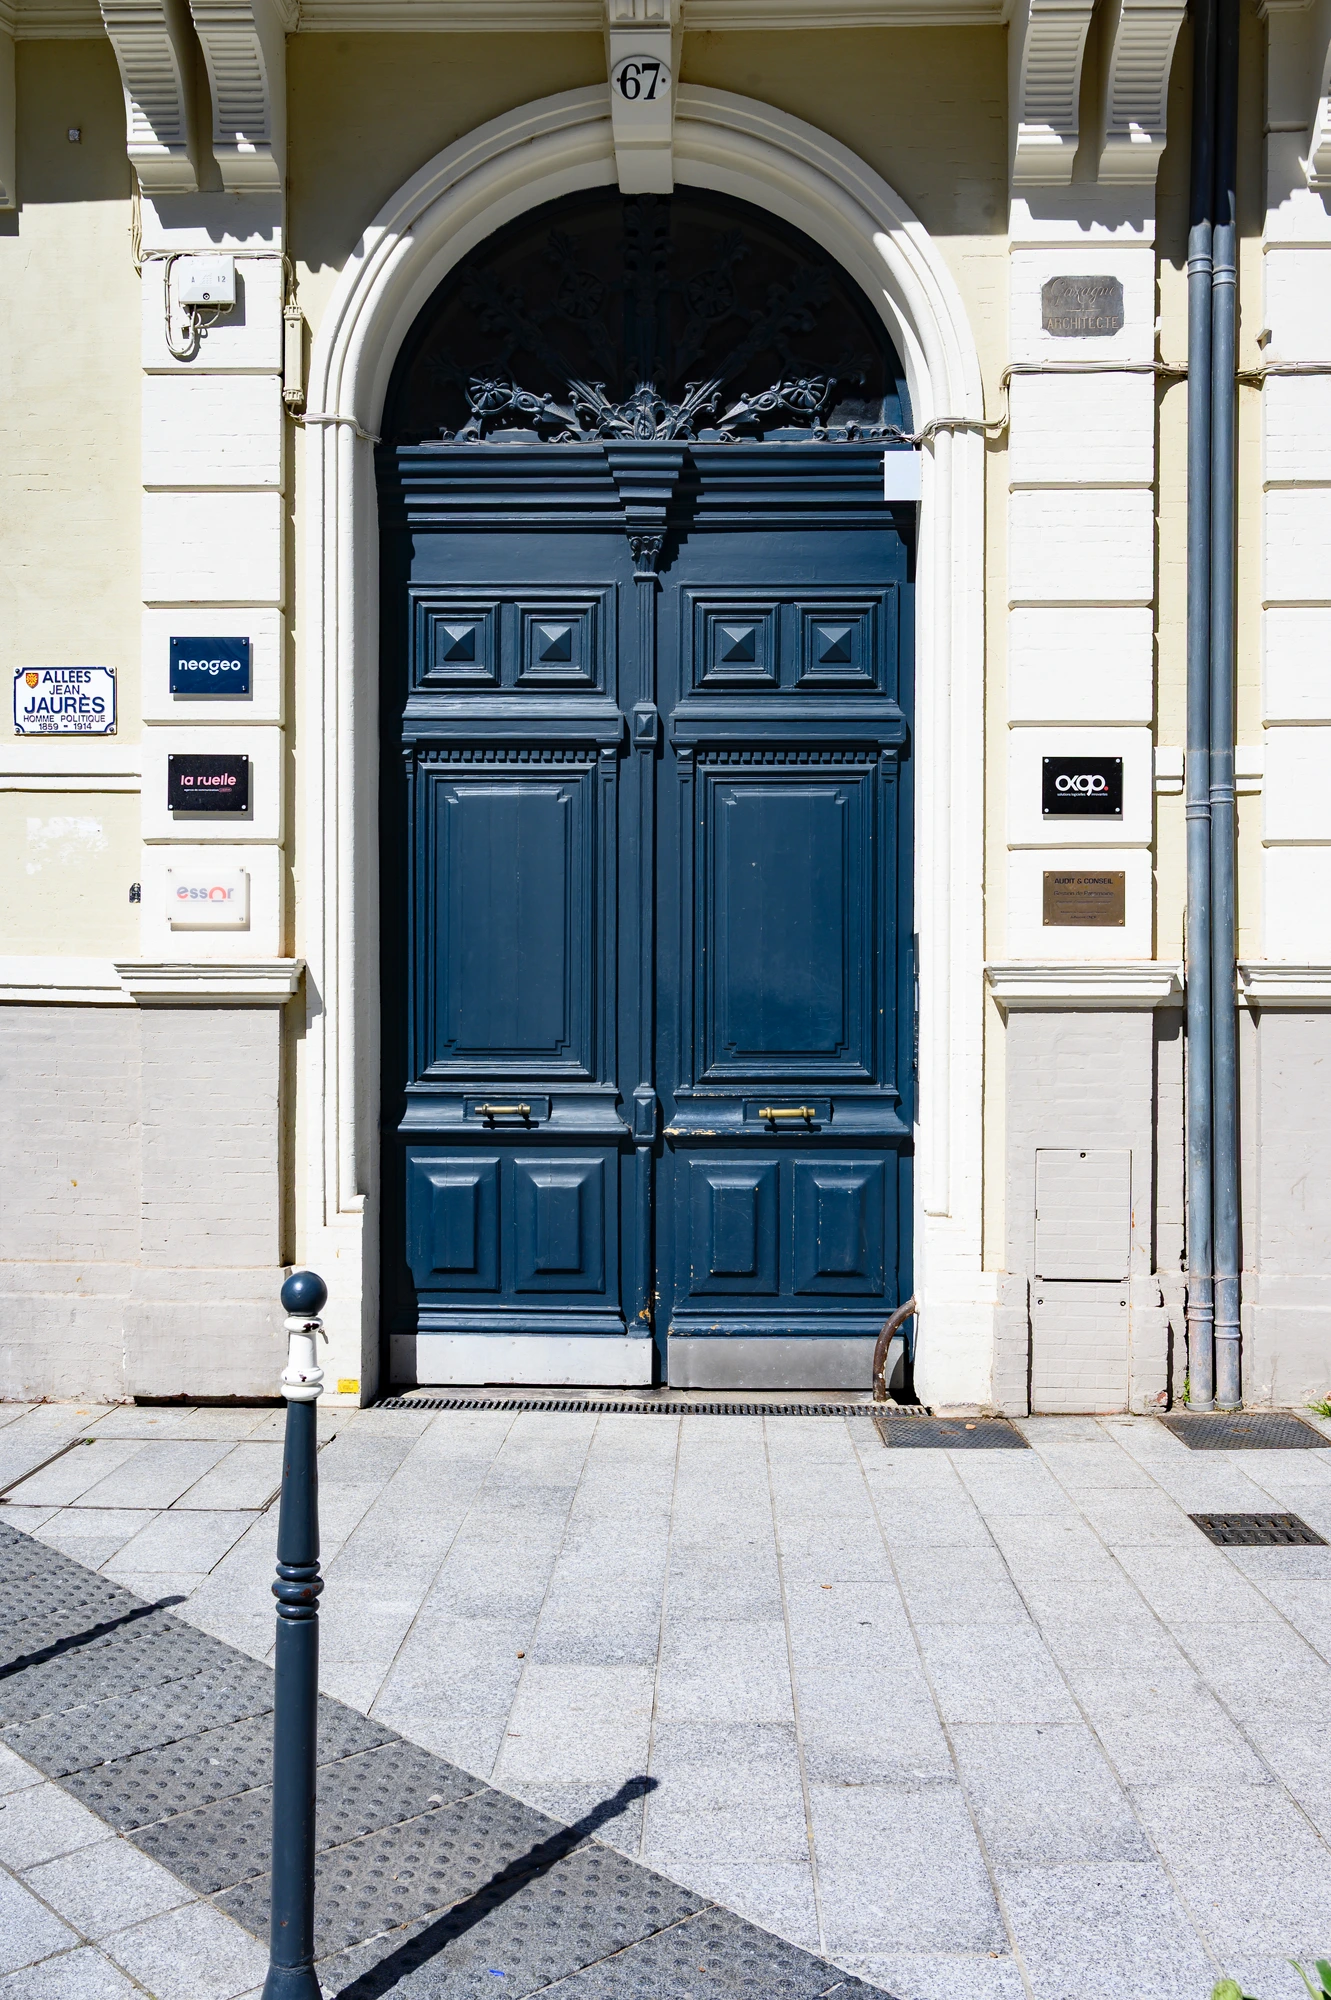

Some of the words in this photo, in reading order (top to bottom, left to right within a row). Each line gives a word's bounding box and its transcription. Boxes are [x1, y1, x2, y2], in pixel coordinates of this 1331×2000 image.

[620, 63, 660, 100] 67
[1047, 316, 1119, 329] ARCHITECTE
[178, 660, 241, 675] neogeo
[42, 669, 91, 683] ALLÉES
[49, 685, 80, 695] JEAN
[24, 693, 105, 714] JAURÈS
[23, 715, 55, 723] HOMME
[60, 715, 106, 723] POLITIQUE
[74, 723, 92, 731] 1914
[180, 775, 194, 786] la
[197, 773, 237, 786] ruelle
[177, 886, 234, 900] essor
